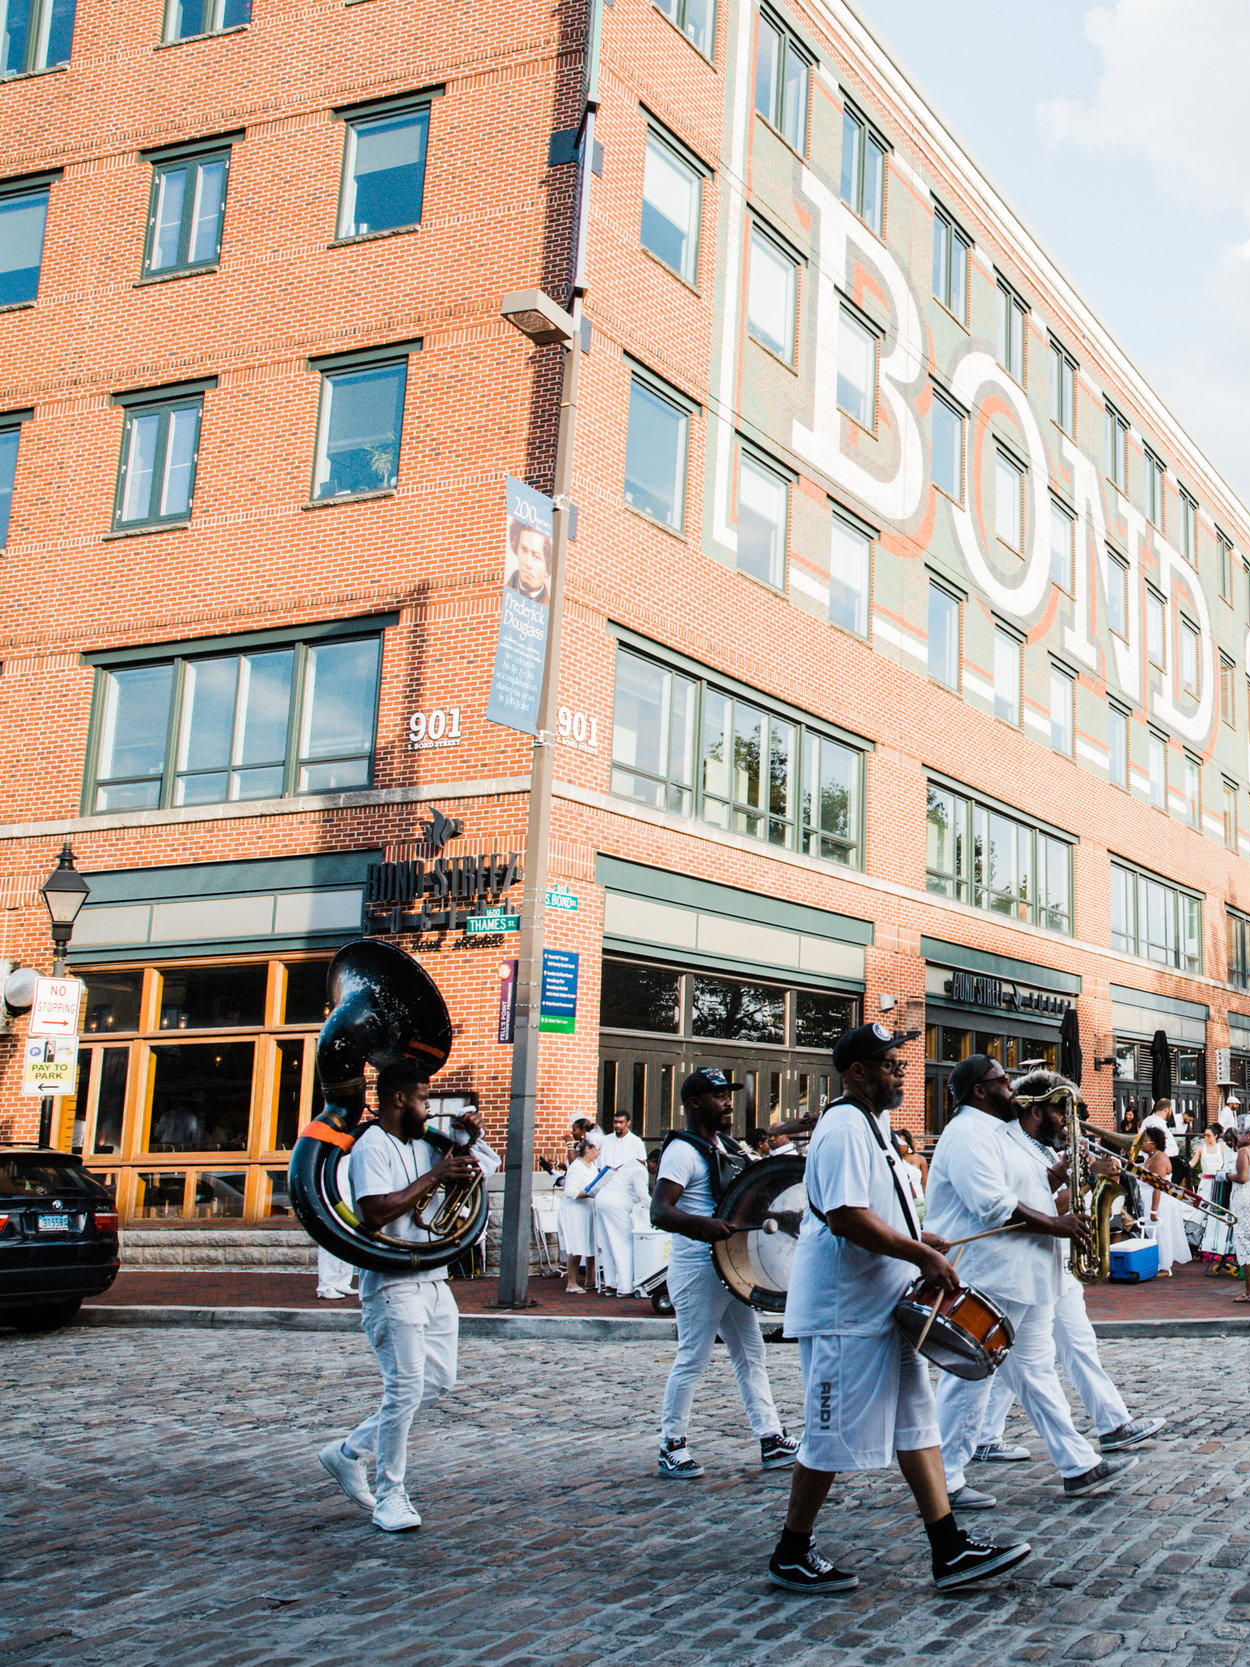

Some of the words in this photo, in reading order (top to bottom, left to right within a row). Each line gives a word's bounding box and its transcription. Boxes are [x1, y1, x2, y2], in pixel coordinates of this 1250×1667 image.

[792, 164, 1214, 744] BOND
[513, 496, 536, 524] 200
[505, 592, 545, 625] Frederick
[503, 609, 544, 641] Douglass
[409, 708, 462, 742] 901
[558, 706, 598, 747] 901
[434, 740, 461, 748] STREET
[366, 860, 424, 902] BOND
[434, 852, 522, 898] STREET
[486, 908, 500, 916] 1600
[545, 894, 550, 904] S
[552, 894, 572, 908] BOND
[470, 918, 506, 932] THAMES
[50, 986, 66, 996] NO
[953, 972, 975, 1003] BOND
[976, 976, 1004, 1008] STREET
[37, 1002, 76, 1014] STOPPING
